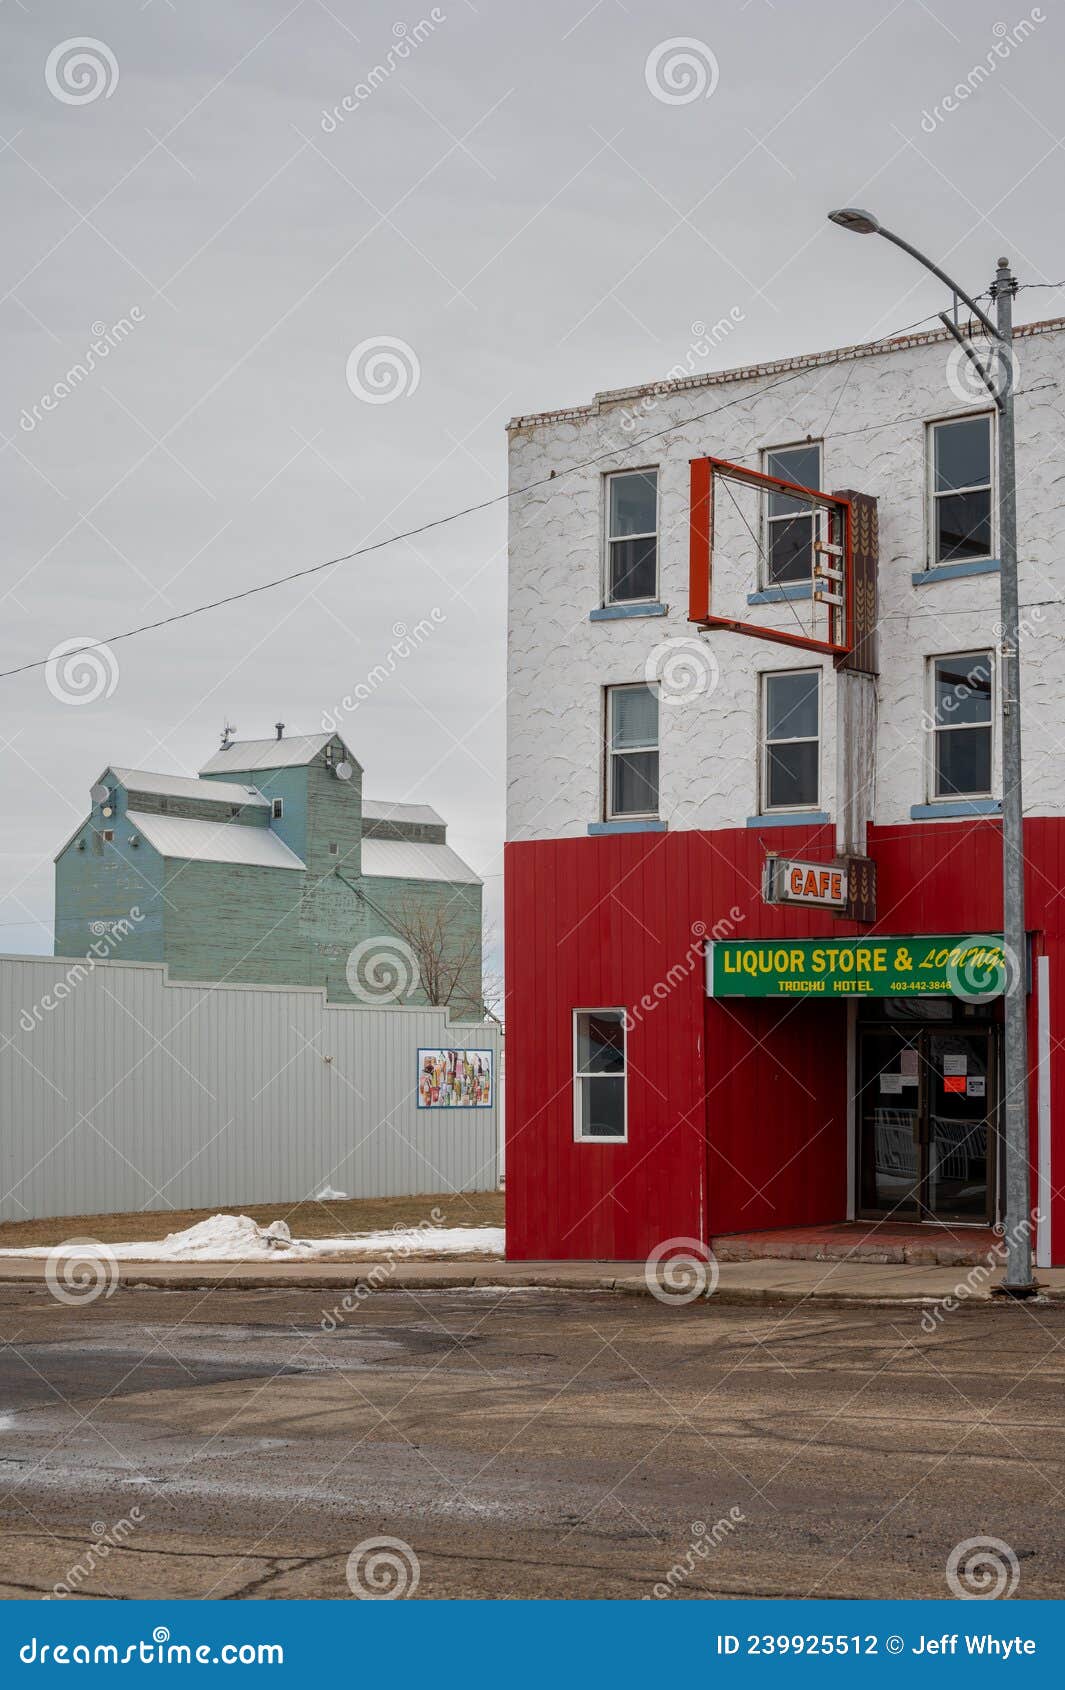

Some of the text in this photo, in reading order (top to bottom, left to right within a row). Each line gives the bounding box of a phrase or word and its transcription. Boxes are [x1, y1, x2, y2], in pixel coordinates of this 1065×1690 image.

[790, 867, 842, 899] CAFE
[724, 949, 805, 977] LIQUOR
[811, 948, 888, 973] STORE
[893, 947, 913, 972] &
[778, 980, 952, 992] TROCHU HOTEL 403-442-3846
